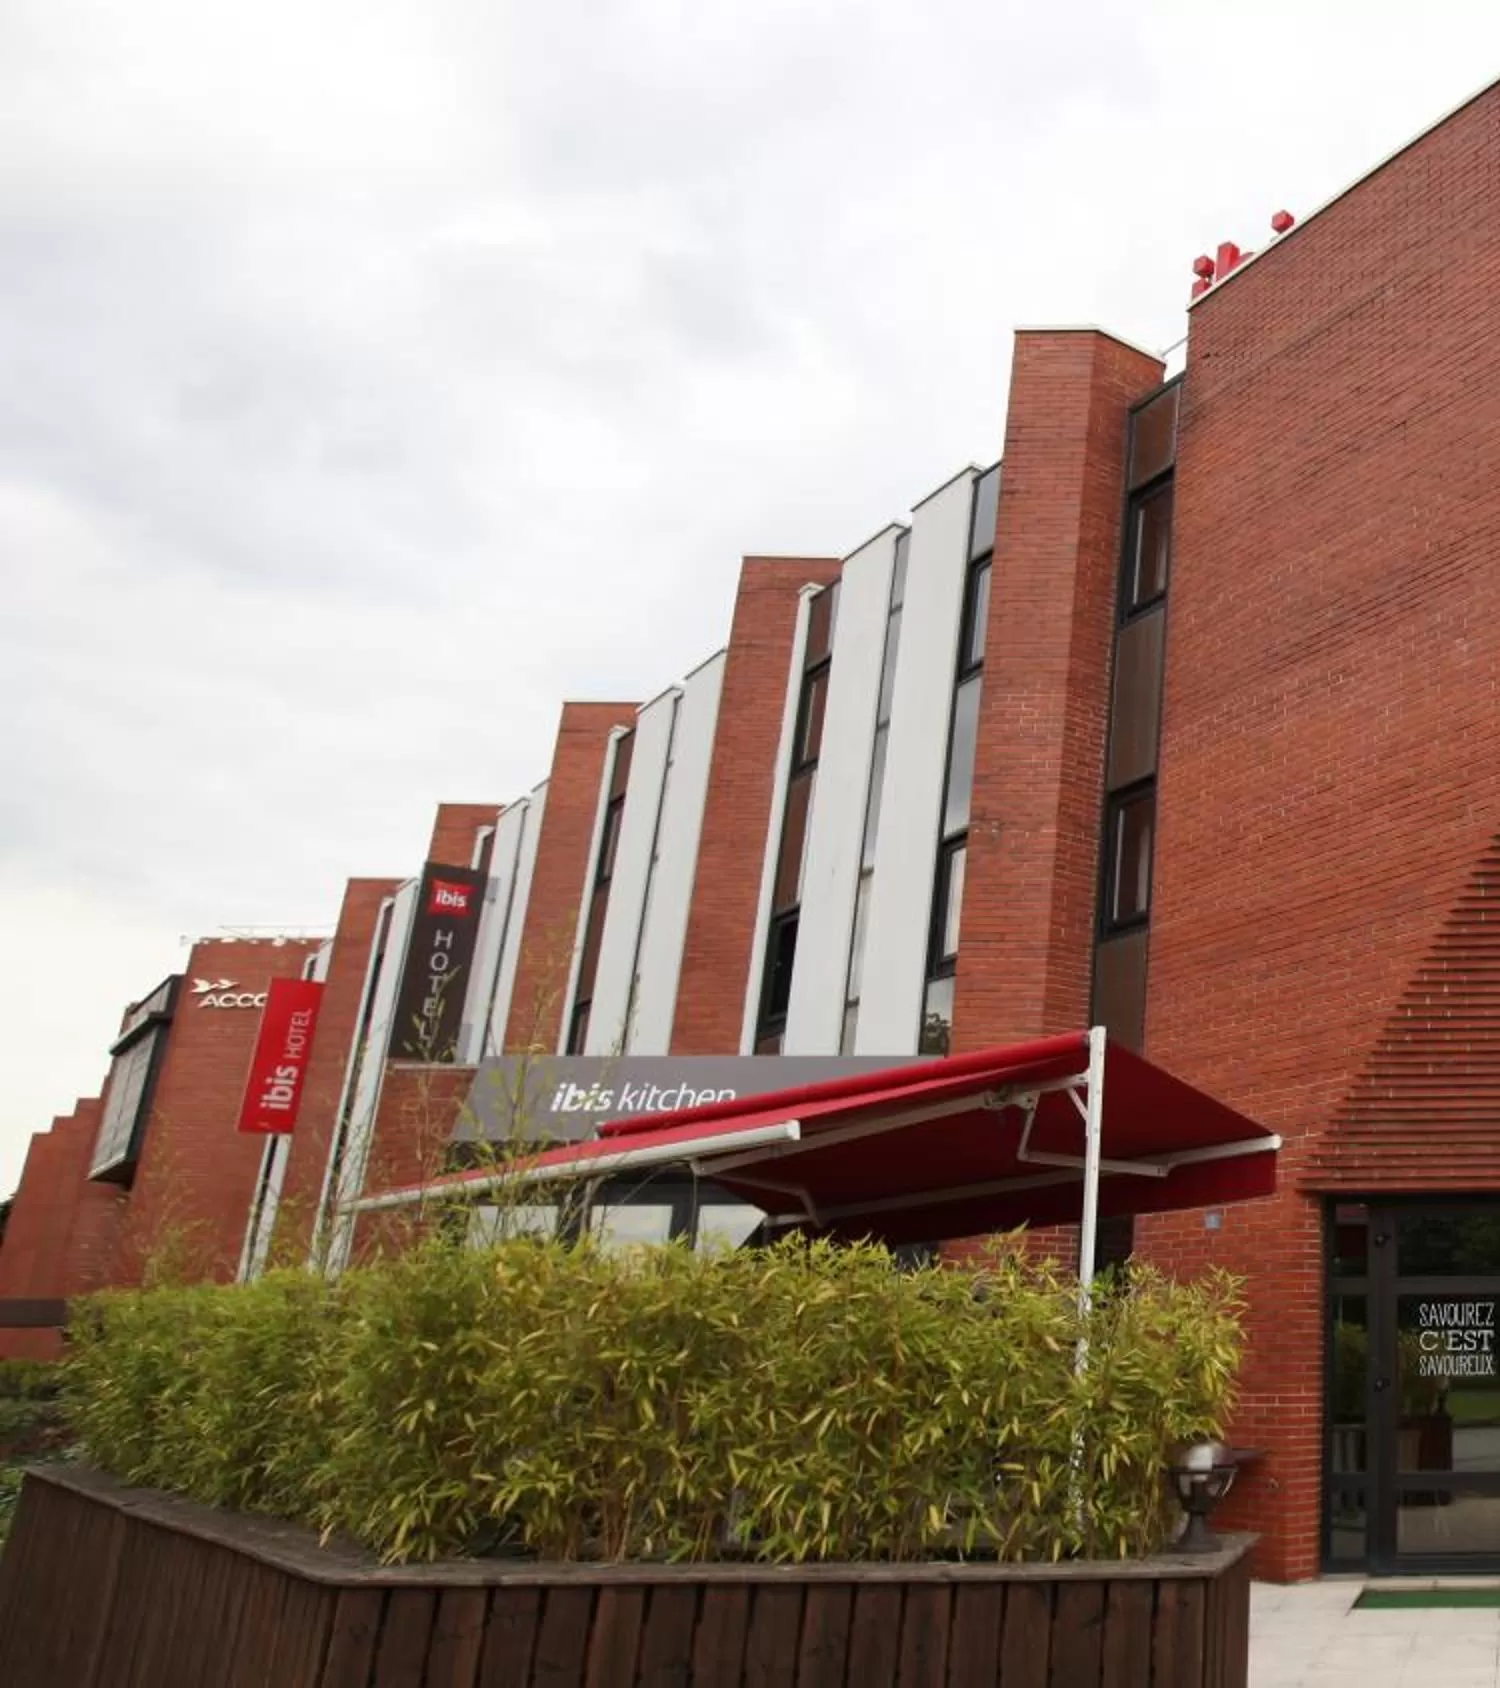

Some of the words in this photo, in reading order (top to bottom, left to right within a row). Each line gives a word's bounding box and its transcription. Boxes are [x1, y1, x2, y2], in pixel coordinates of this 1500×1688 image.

[434, 889, 467, 908] ibis
[260, 1065, 298, 1110] ibis
[284, 1008, 313, 1059] HOTEL
[551, 1082, 614, 1112] ibis
[617, 1082, 736, 1112] kitchen
[1419, 1302, 1495, 1327] SAVOUREZ
[1420, 1330, 1494, 1351] C'EST
[1419, 1355, 1495, 1376] SAVOUREUX
